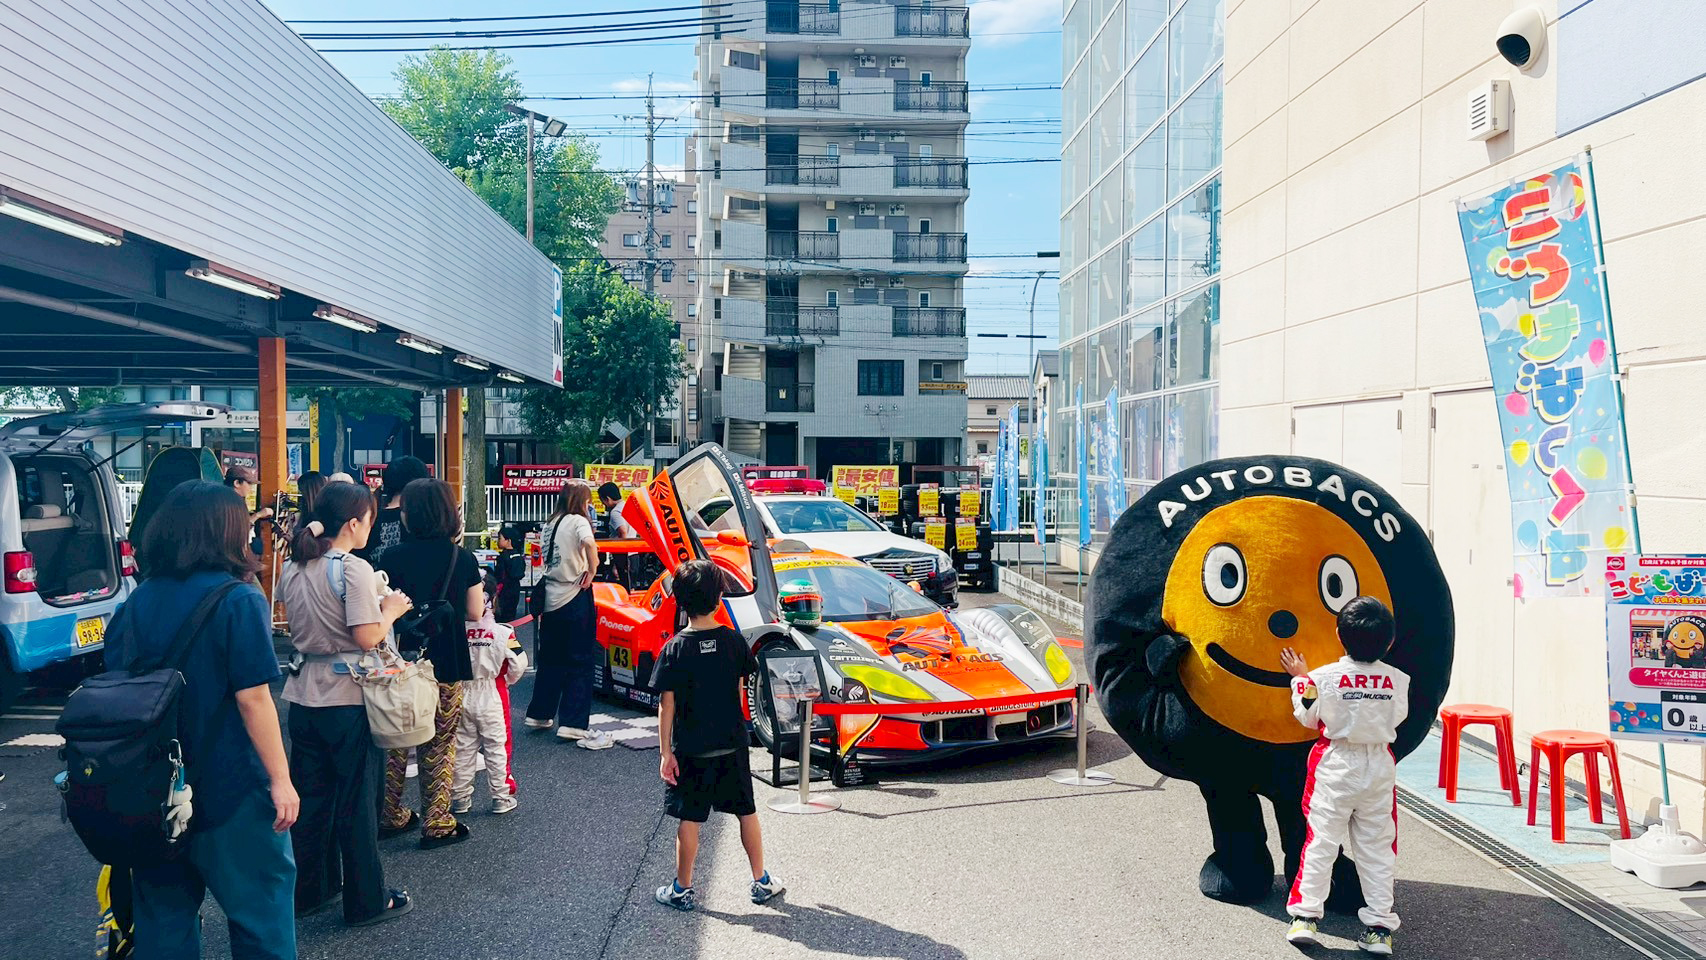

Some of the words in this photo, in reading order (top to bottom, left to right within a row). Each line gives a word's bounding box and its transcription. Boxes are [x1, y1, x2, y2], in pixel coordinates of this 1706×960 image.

[1157, 465, 1401, 542] AUTOBACS
[659, 503, 690, 563] AUTO
[599, 616, 636, 632] Pioneer
[1669, 616, 1706, 629] AUTOBACS
[467, 629, 494, 640] RTA
[613, 647, 629, 668] 43
[829, 655, 884, 665] carrozzeria
[902, 653, 1004, 672] AUTBACS
[1338, 674, 1394, 690] ARTA
[748, 673, 760, 728] BRIDGES
[1363, 693, 1393, 701] MUGEN
[1667, 707, 1685, 727] 0
